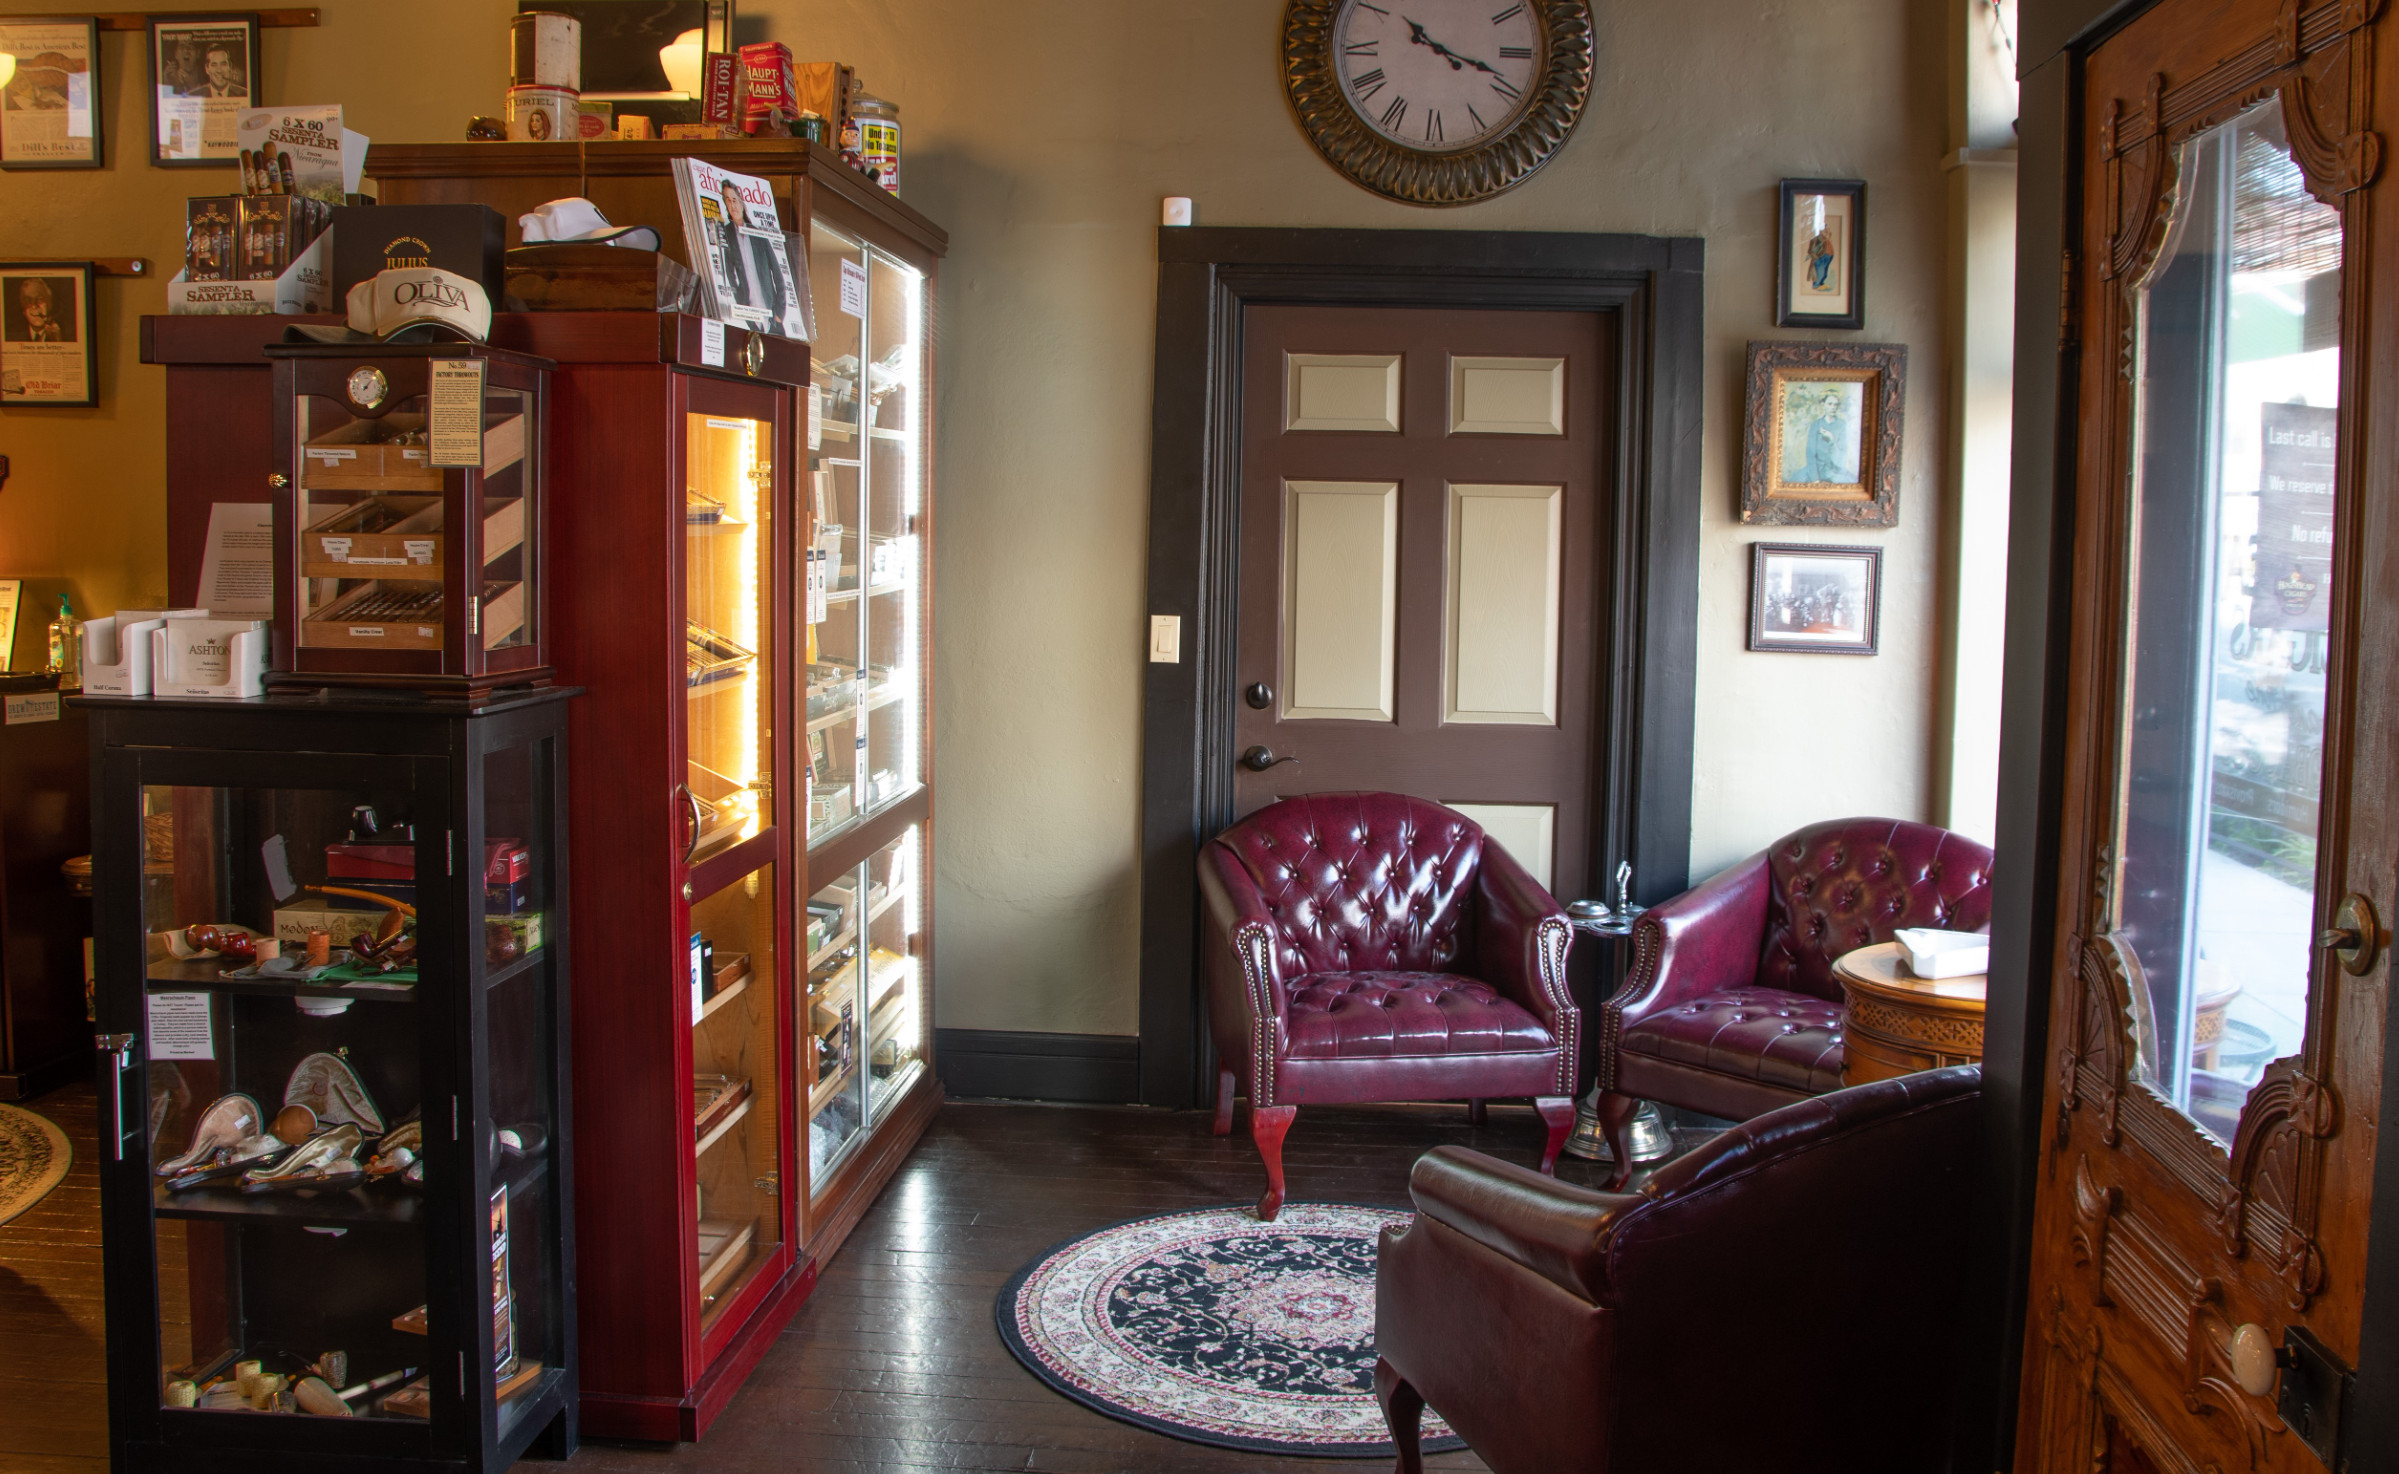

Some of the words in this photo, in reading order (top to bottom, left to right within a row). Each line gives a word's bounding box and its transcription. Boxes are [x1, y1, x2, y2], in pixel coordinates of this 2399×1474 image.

[716, 58, 731, 119] ROI-TAN
[283, 117, 291, 127] 6
[293, 118, 304, 129] X
[308, 120, 323, 131] 60
[269, 129, 340, 150] SAMPLER
[281, 127, 324, 140] SESENTA
[22, 143, 48, 152] Dill's
[51, 143, 75, 151] Best
[289, 147, 338, 168] Nicaragua
[384, 236, 411, 255] DIAMOND
[411, 237, 431, 254] CROWN
[386, 257, 428, 269] JULIUS
[187, 289, 256, 302] SAMPLER
[395, 278, 471, 312] OLIVA
[458, 361, 467, 369] 59
[25, 381, 40, 390] Old
[41, 381, 62, 390] Briar
[2268, 426, 2295, 446] Last
[2297, 430, 2318, 448] call
[2321, 432, 2331, 449] is
[2268, 475, 2285, 491] We
[2287, 481, 2326, 495] reserve
[2291, 524, 2307, 542] No
